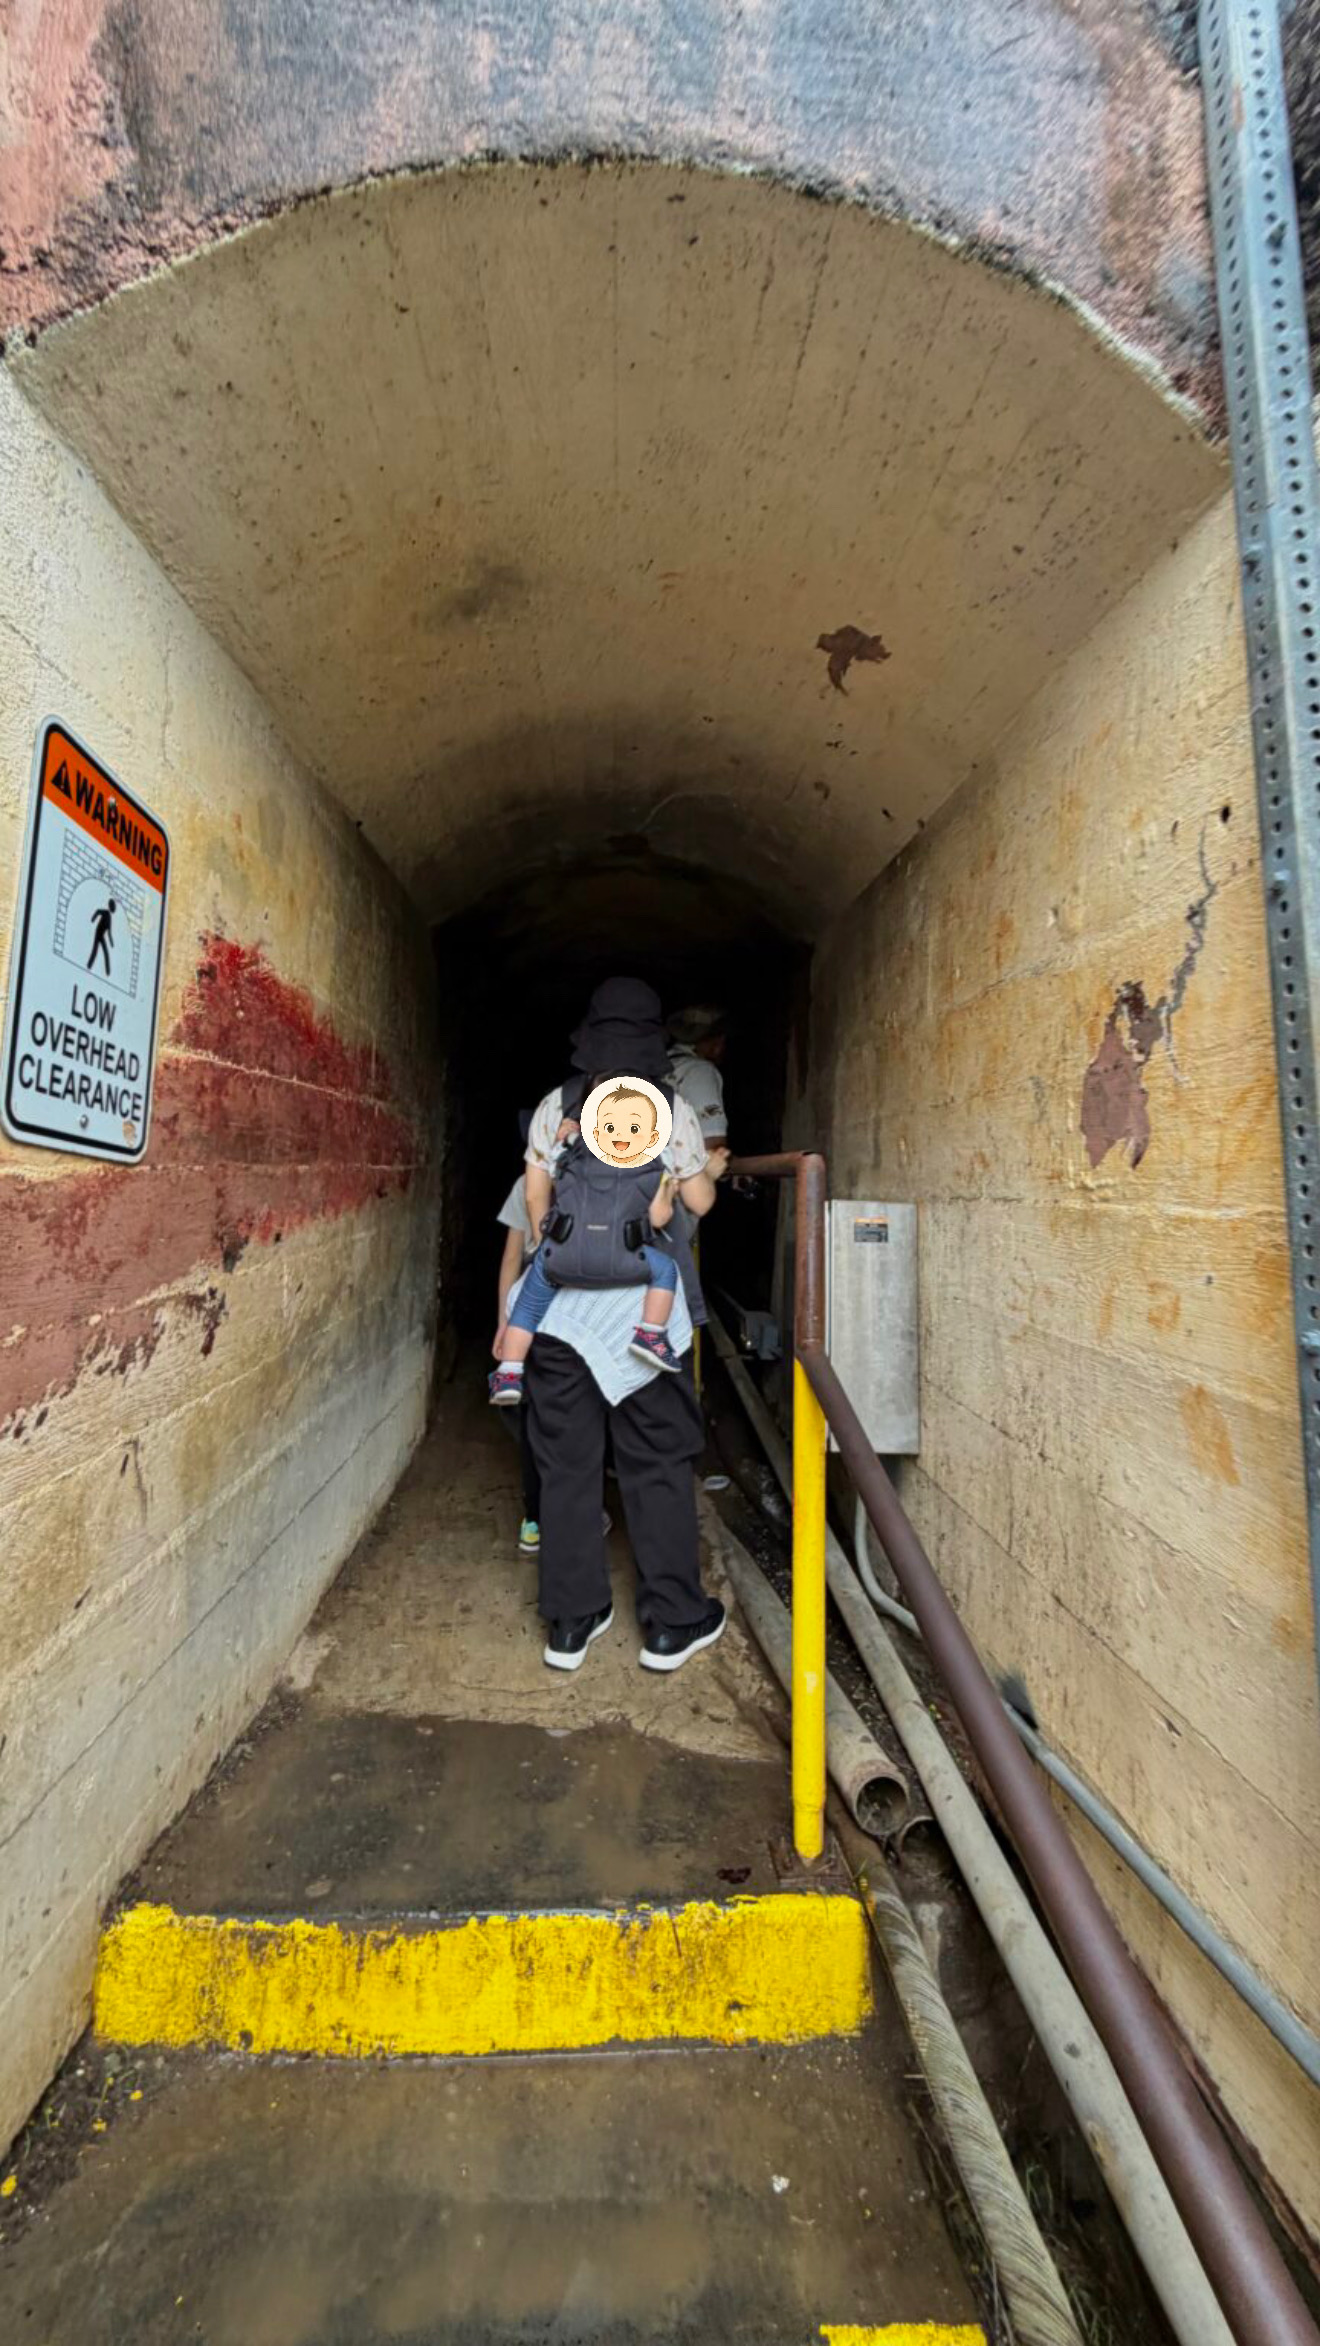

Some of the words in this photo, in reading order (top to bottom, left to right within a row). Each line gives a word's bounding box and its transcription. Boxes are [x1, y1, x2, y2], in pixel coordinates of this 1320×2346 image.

[75, 769, 163, 876] WARNING
[70, 984, 117, 1033] LOW
[30, 1010, 140, 1082] OVERHEAD
[18, 1053, 143, 1122] CLEARANCE
